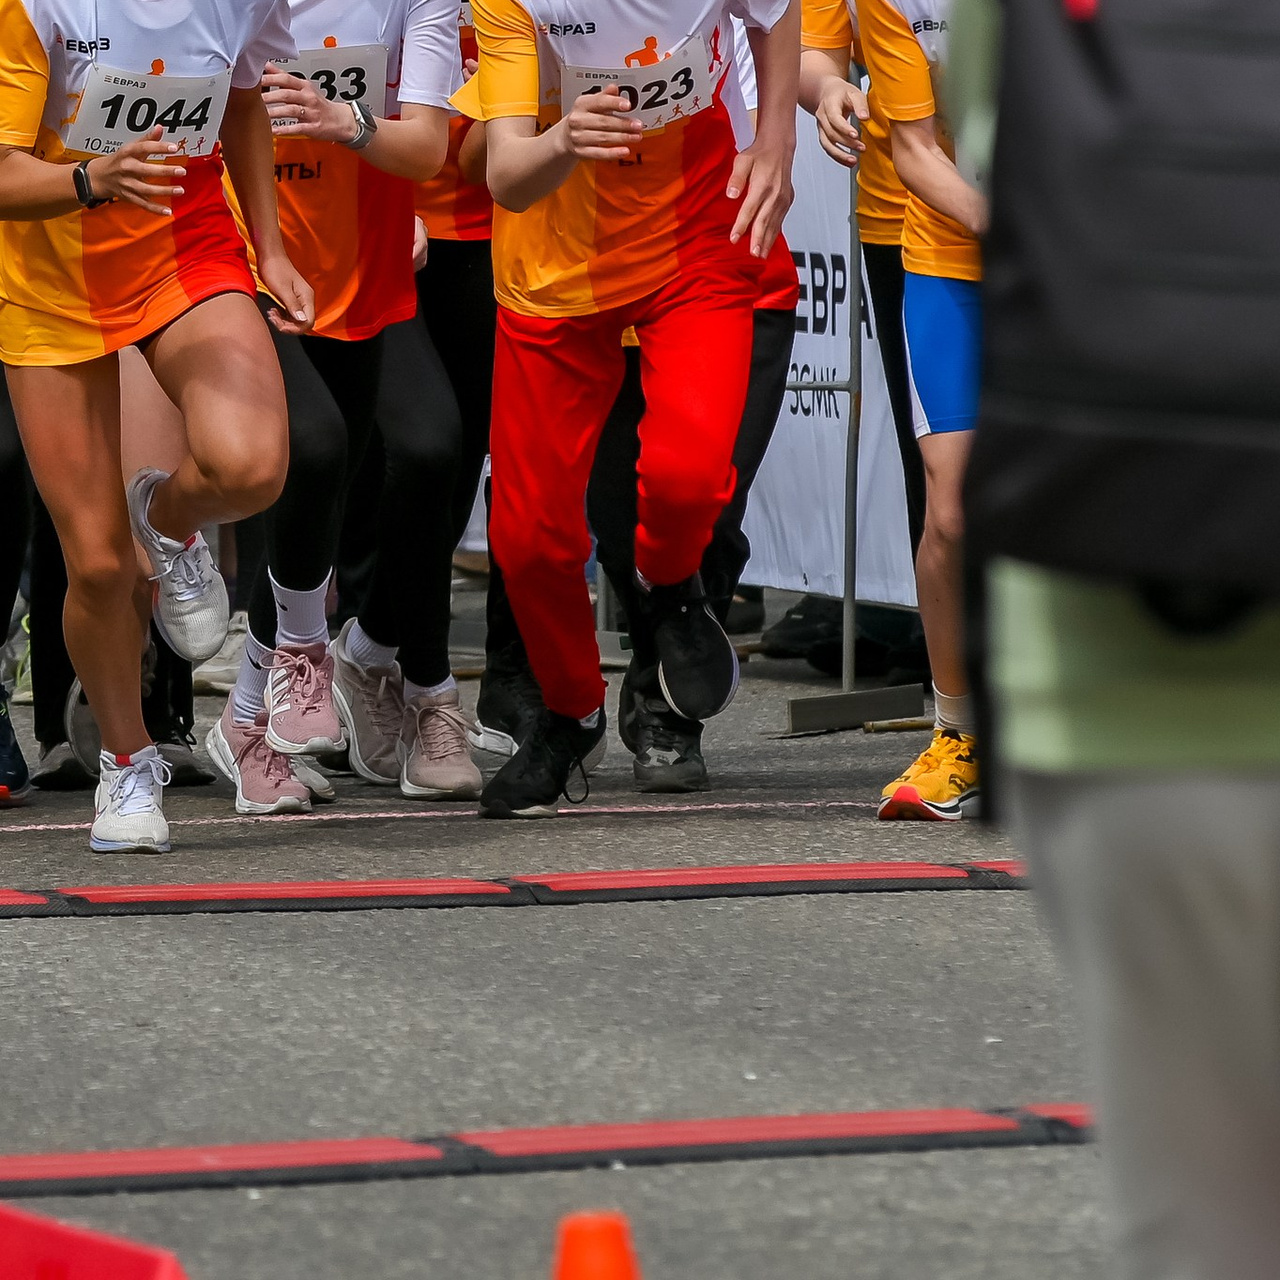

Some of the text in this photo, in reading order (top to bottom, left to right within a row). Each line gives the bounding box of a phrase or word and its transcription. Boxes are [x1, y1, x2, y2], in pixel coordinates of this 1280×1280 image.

[113, 76, 147, 89] ЕВРАЗ
[100, 93, 213, 134] 1044
[84, 137, 103, 151] 10
